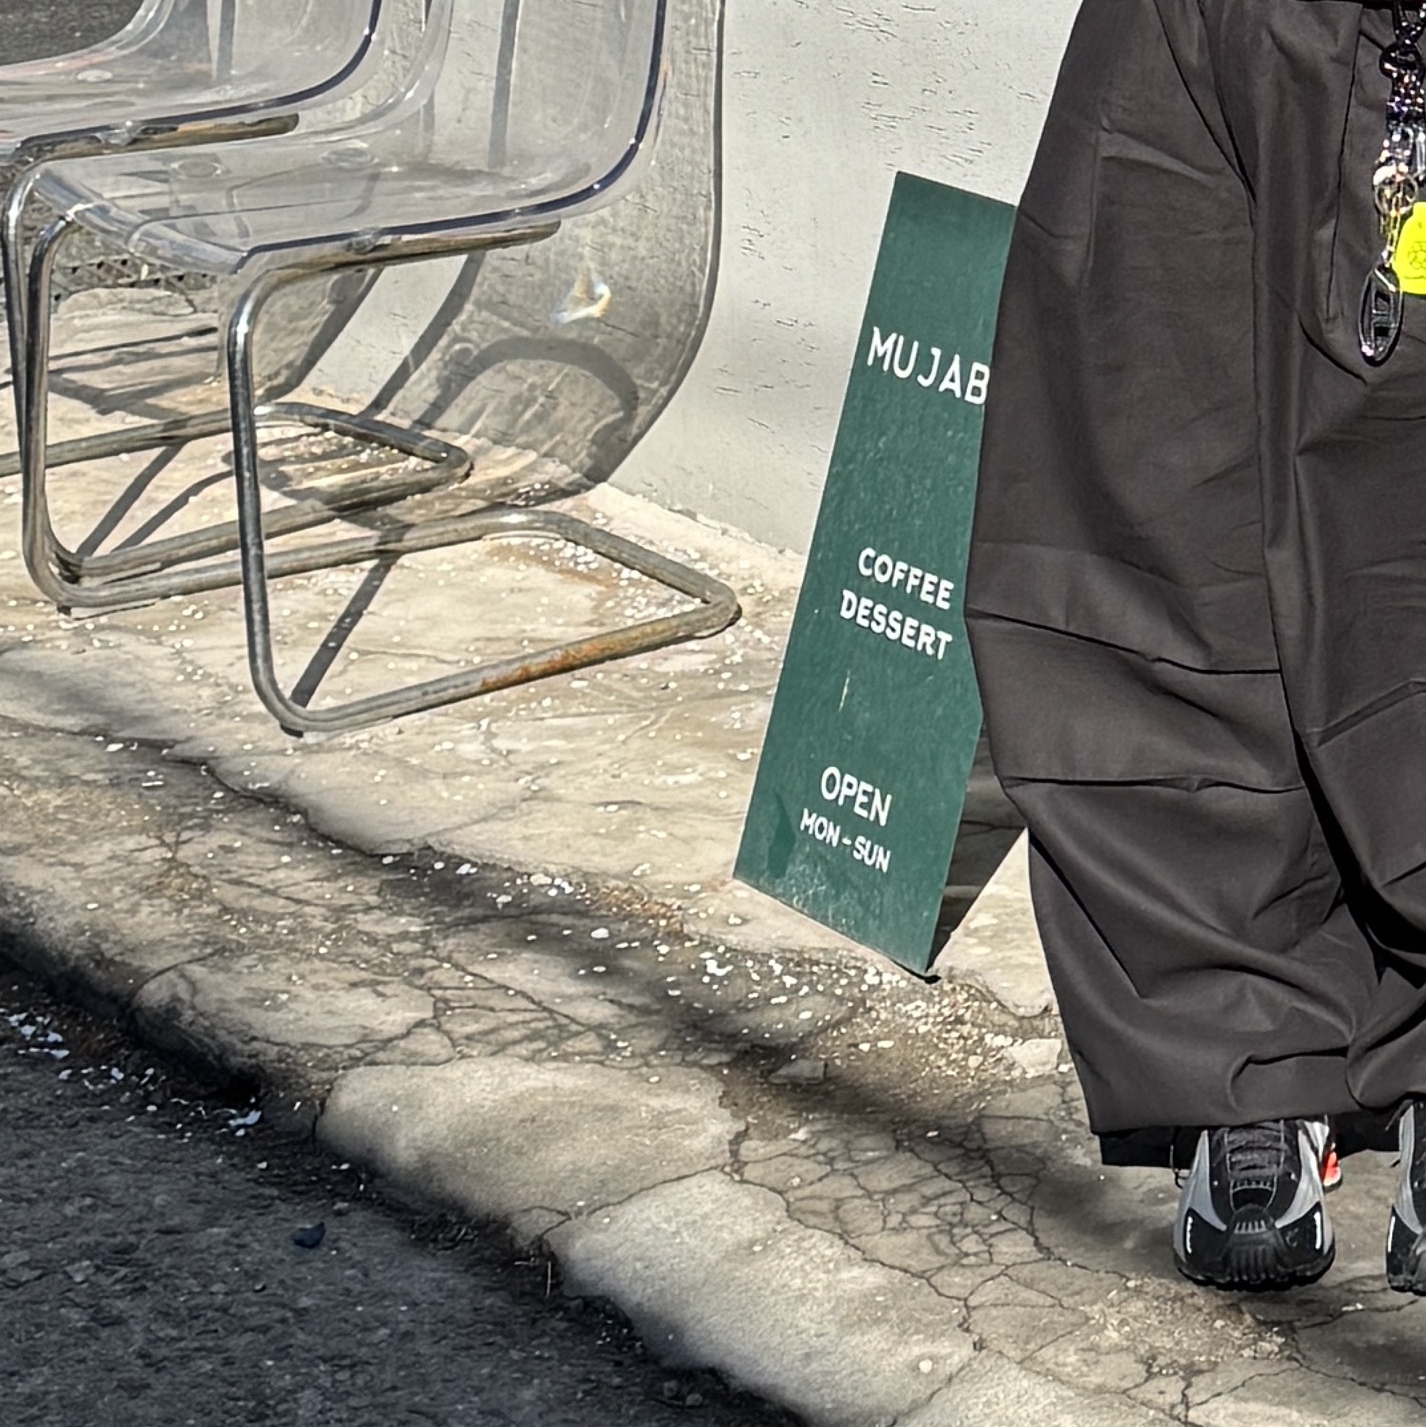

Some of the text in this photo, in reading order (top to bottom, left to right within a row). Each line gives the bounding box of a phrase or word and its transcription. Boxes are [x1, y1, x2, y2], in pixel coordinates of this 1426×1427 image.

[858, 547, 955, 610] COFFEE
[839, 589, 953, 660] DESSERT
[821, 766, 892, 827] OPEN
